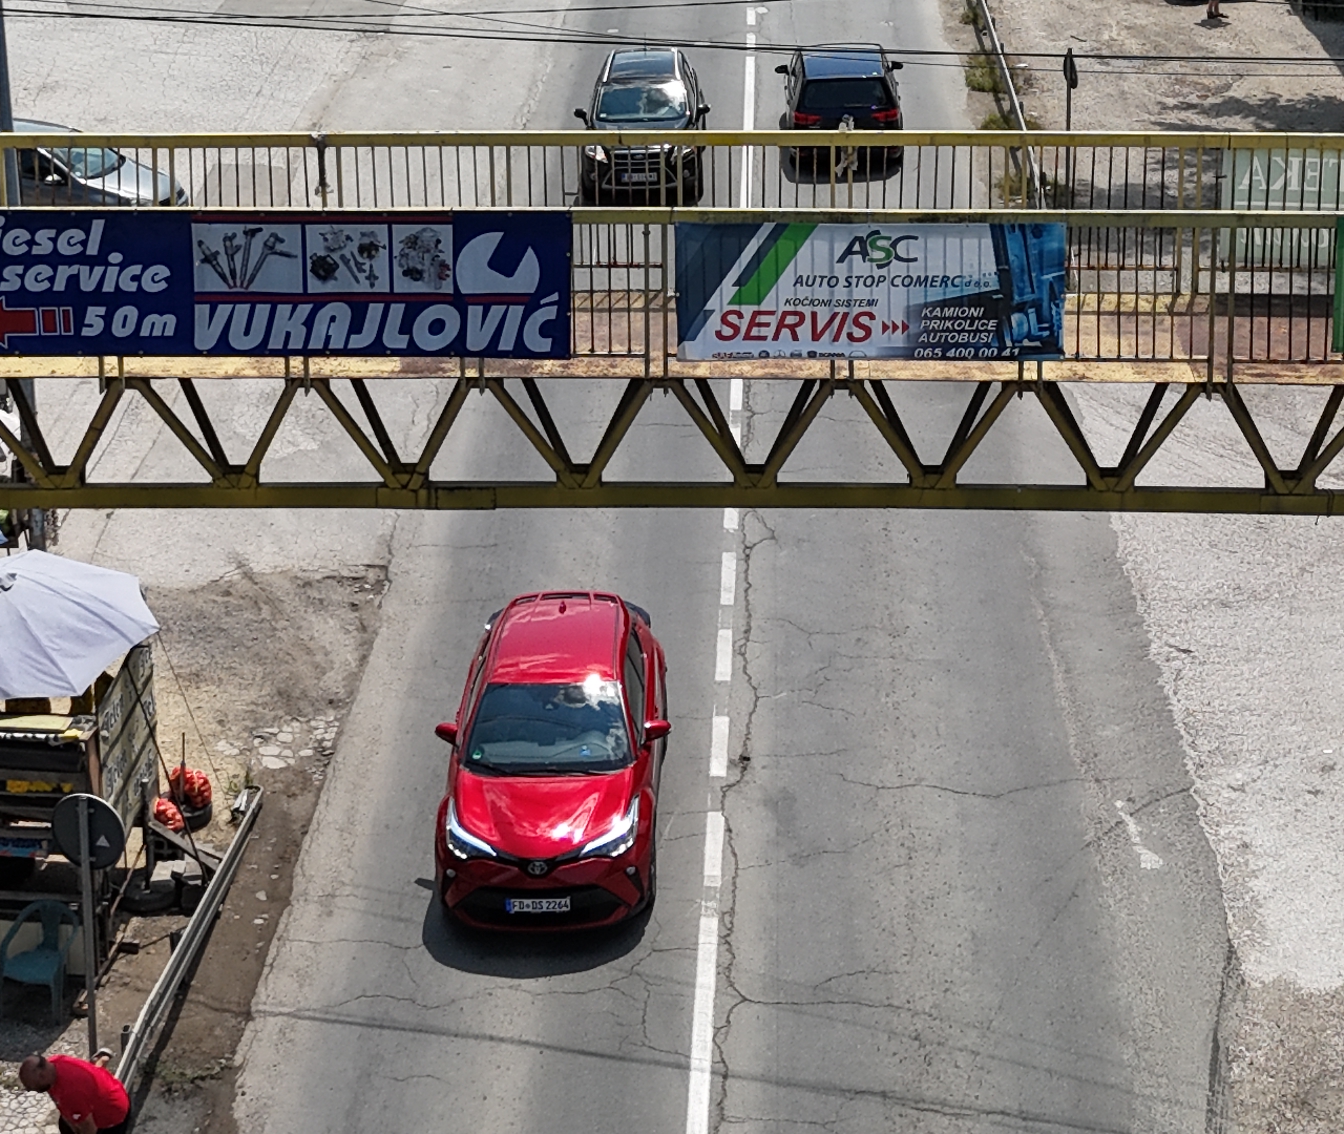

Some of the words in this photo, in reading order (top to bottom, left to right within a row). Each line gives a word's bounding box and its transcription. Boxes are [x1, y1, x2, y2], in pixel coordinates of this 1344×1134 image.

[836, 229, 920, 270] ASC
[0, 252, 172, 293] service
[793, 274, 839, 289] AUTO
[843, 274, 887, 289] STOP
[890, 274, 964, 289] COMERC
[784, 296, 833, 308] KOČIONI
[834, 298, 879, 308] SISTEMI
[920, 306, 985, 319] KAMIONI
[80, 305, 177, 338] 50m
[193, 293, 560, 353] VUKAJLOVIĆ
[714, 309, 875, 344] SERVIS
[919, 319, 999, 331] PRIKOLICE
[918, 332, 995, 344] AUTOBUSI
[914, 348, 944, 359] 065
[946, 348, 976, 359] 400
[978, 348, 999, 359] 00
[1001, 348, 1021, 358] 41
[531, 900, 544, 911] DS
[545, 900, 570, 911] 2264
